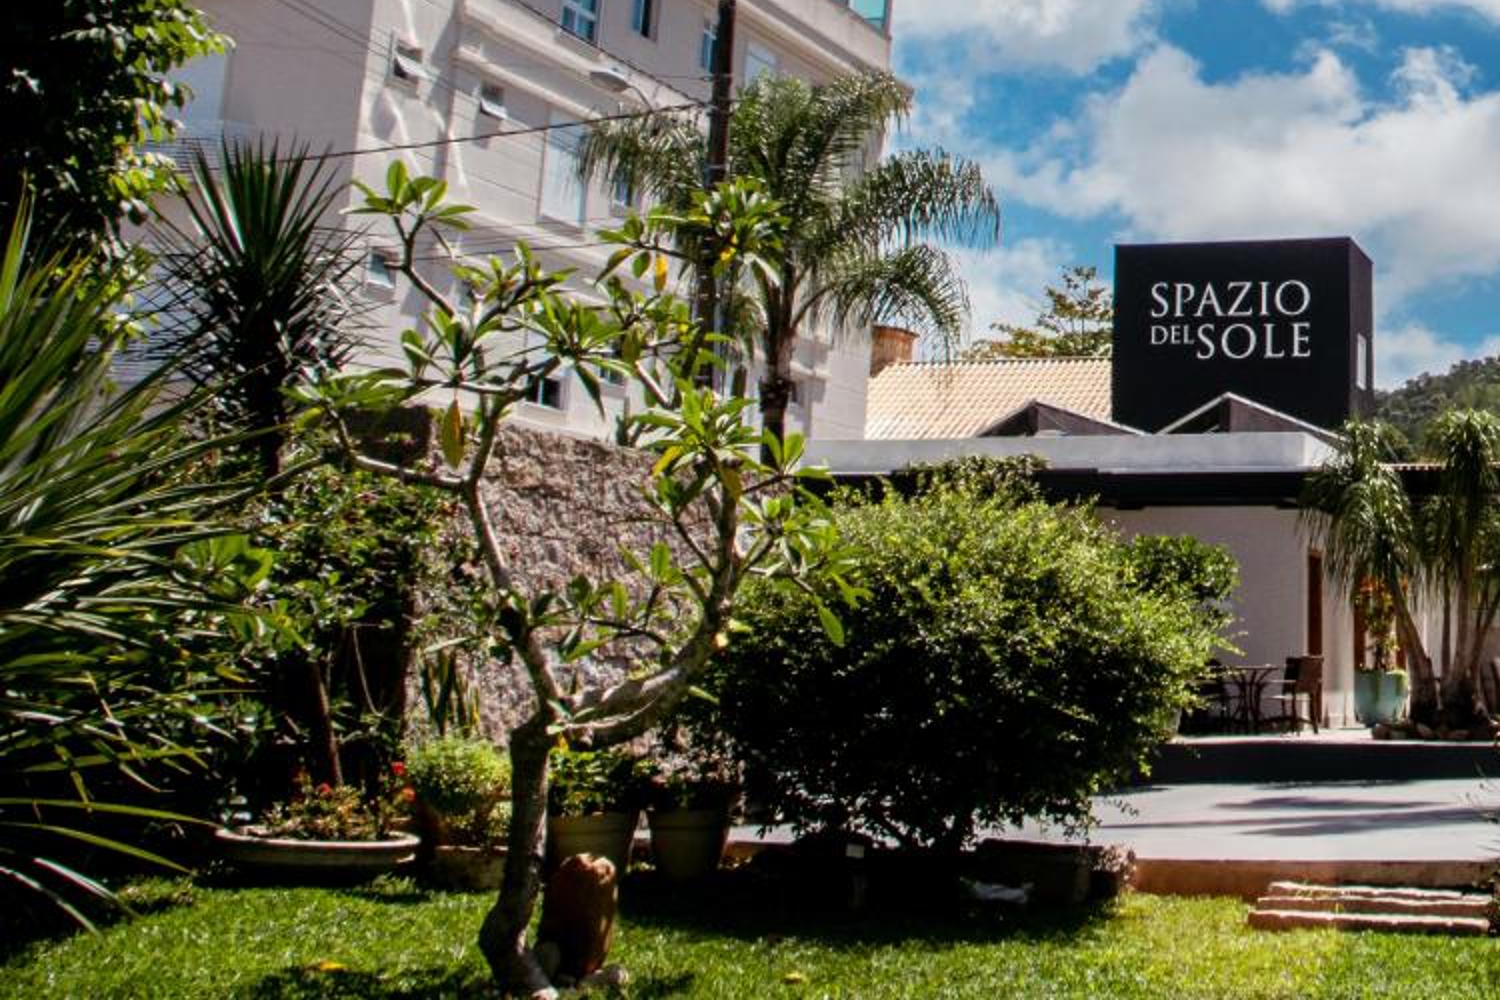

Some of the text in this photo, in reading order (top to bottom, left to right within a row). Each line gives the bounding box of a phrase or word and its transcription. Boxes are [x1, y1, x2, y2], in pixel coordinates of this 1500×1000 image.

[1150, 279, 1312, 318] SPAZIO
[1150, 322, 1312, 360] DEL SOLE
